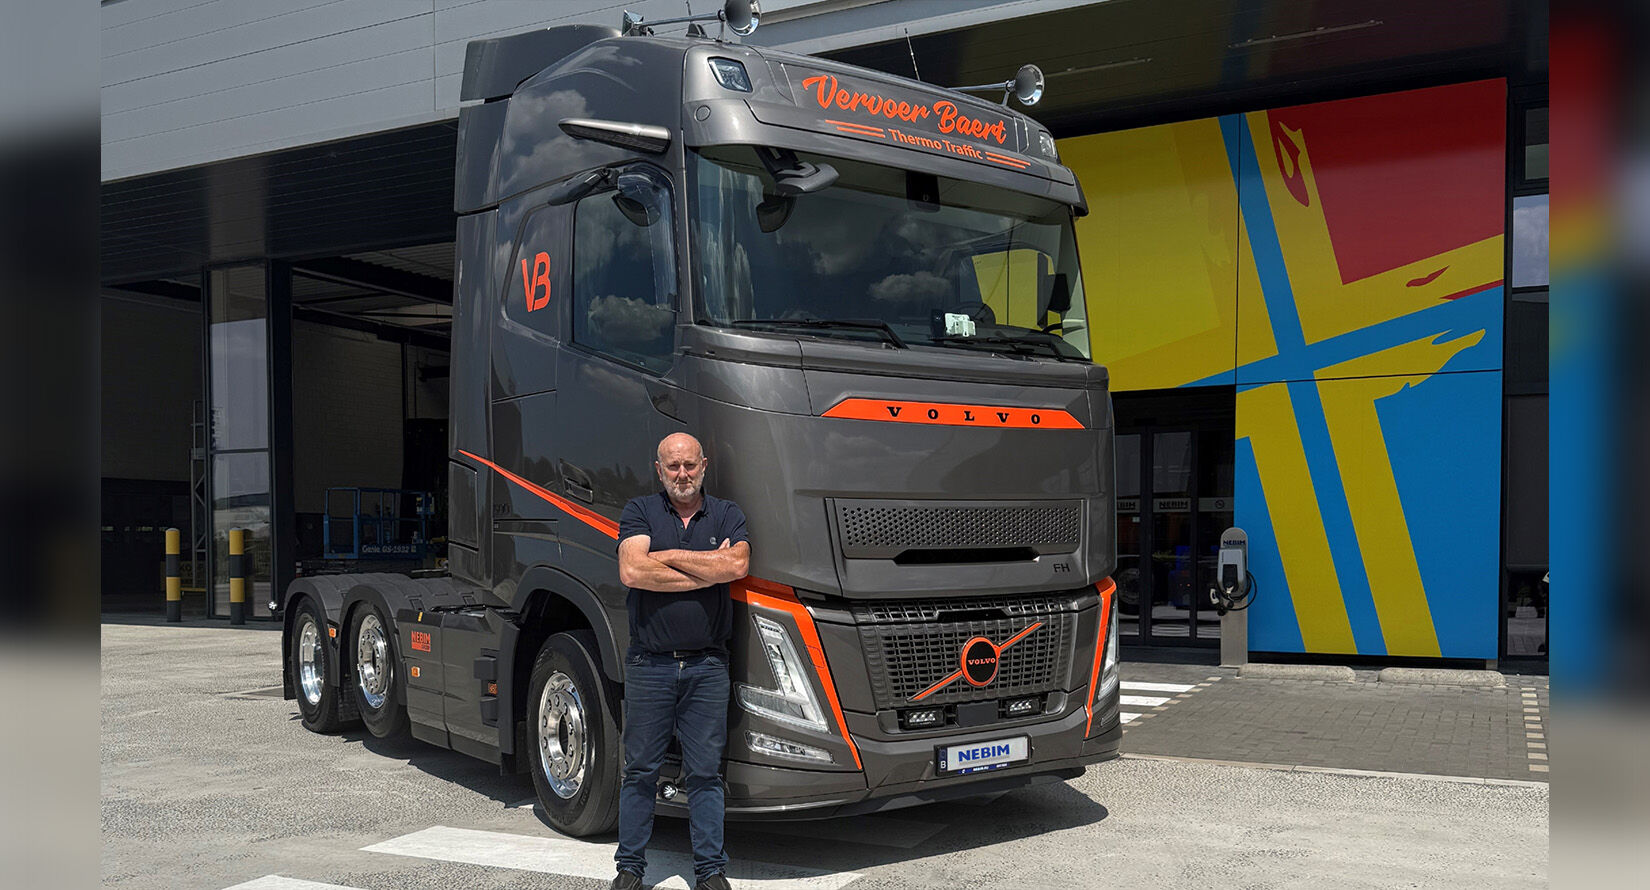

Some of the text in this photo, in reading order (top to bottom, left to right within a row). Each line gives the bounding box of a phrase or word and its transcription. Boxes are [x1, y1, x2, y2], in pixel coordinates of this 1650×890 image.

[802, 75, 1007, 144] Vervoer Baert
[888, 129, 983, 160] Thermo Traffic
[521, 251, 551, 312] VB
[887, 406, 1041, 425] VOLVO
[1053, 563, 1070, 573] FH
[411, 631, 431, 644] NEBIM
[968, 657, 996, 665] VOLVO
[958, 744, 1010, 762] NEBIM
[940, 760, 947, 769] B
